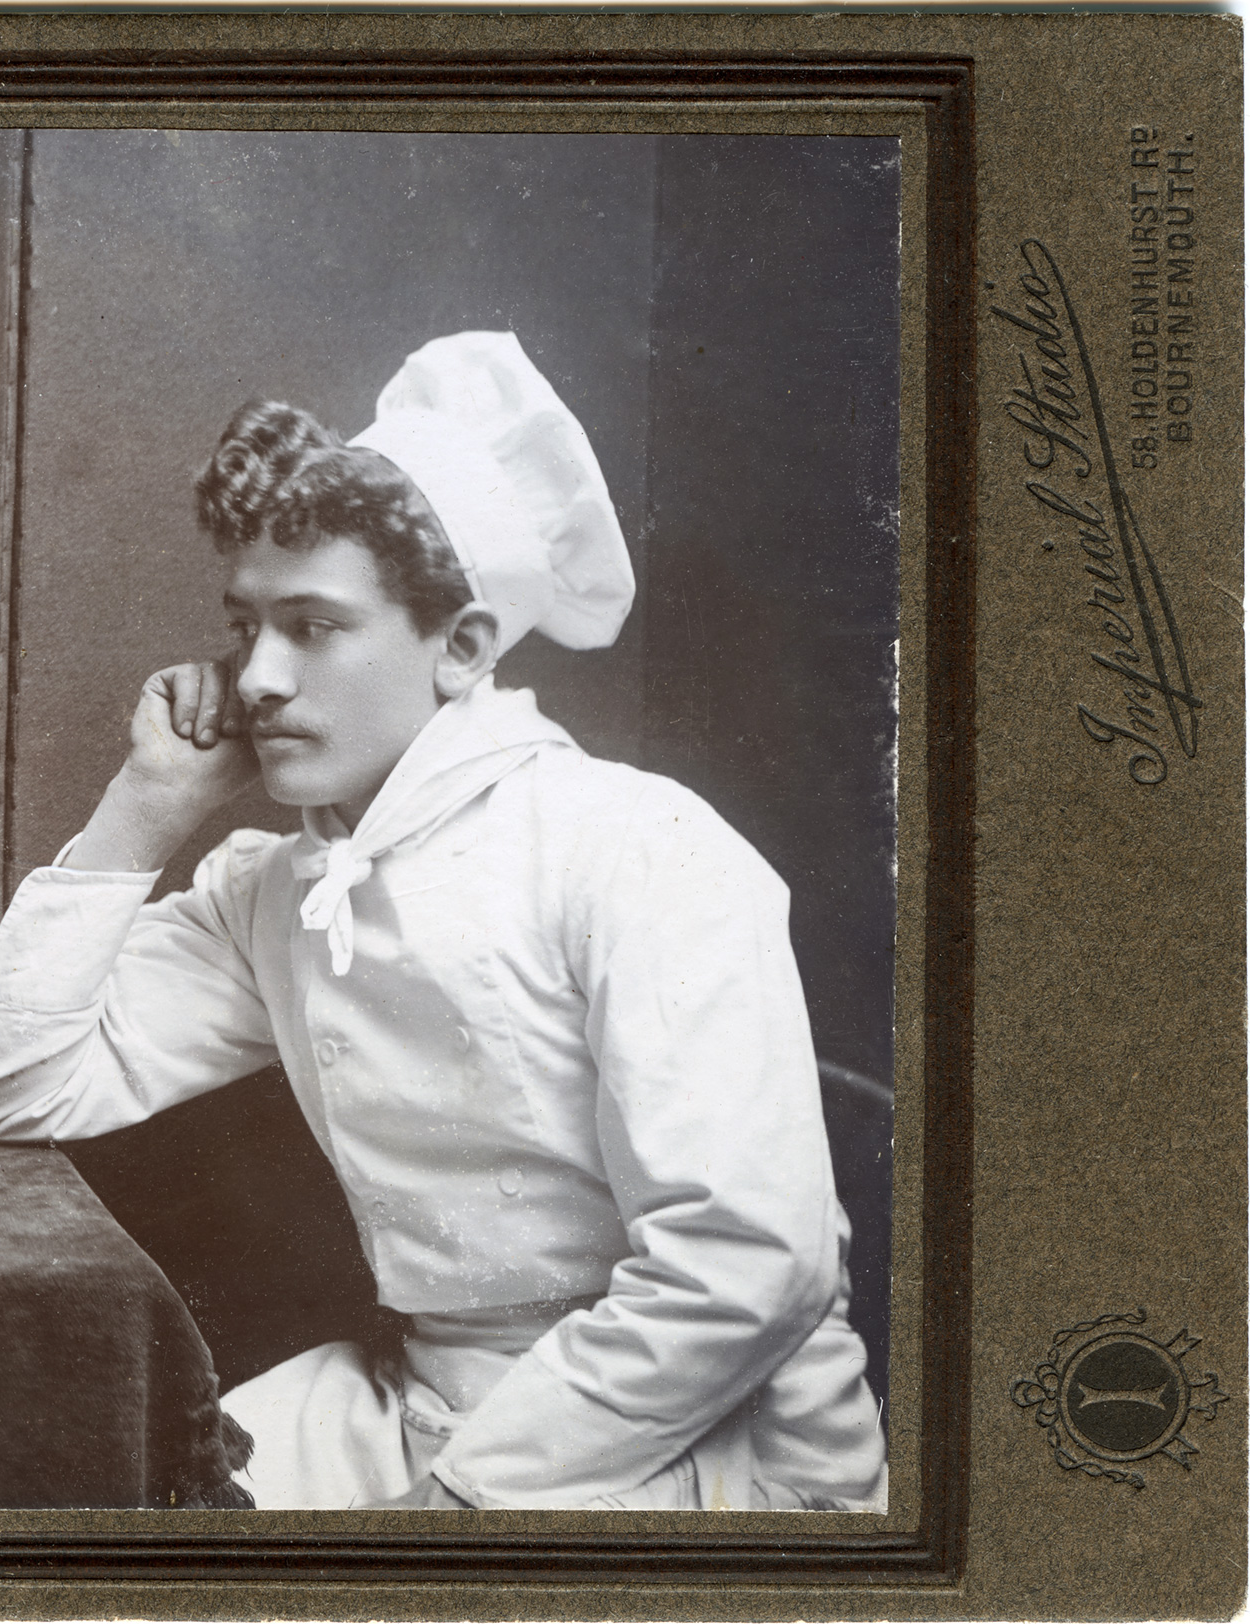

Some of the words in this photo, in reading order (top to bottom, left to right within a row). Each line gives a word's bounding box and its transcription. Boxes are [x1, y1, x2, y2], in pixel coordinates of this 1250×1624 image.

[986, 238, 1093, 478] Studio
[1131, 180, 1159, 421] HOLDENHURST
[1024, 479, 1202, 786] Imperial
